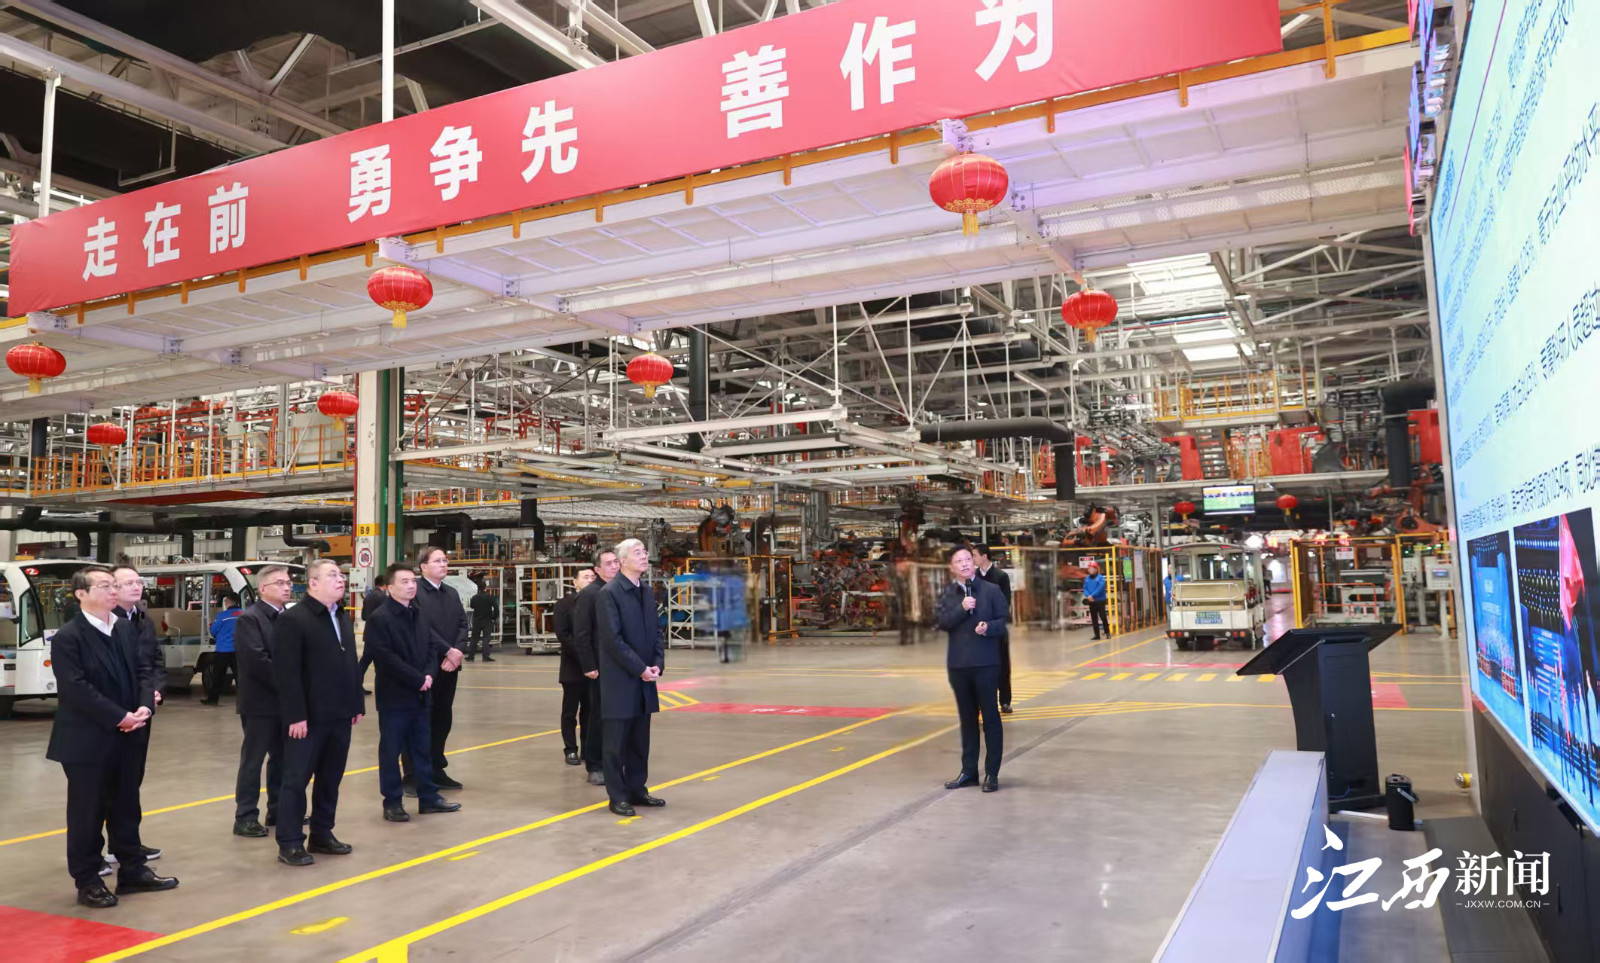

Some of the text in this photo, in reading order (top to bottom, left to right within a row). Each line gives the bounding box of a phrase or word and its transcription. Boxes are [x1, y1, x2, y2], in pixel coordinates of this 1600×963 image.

[82, 0, 1055, 282] 走在前 勇争先 善作为
